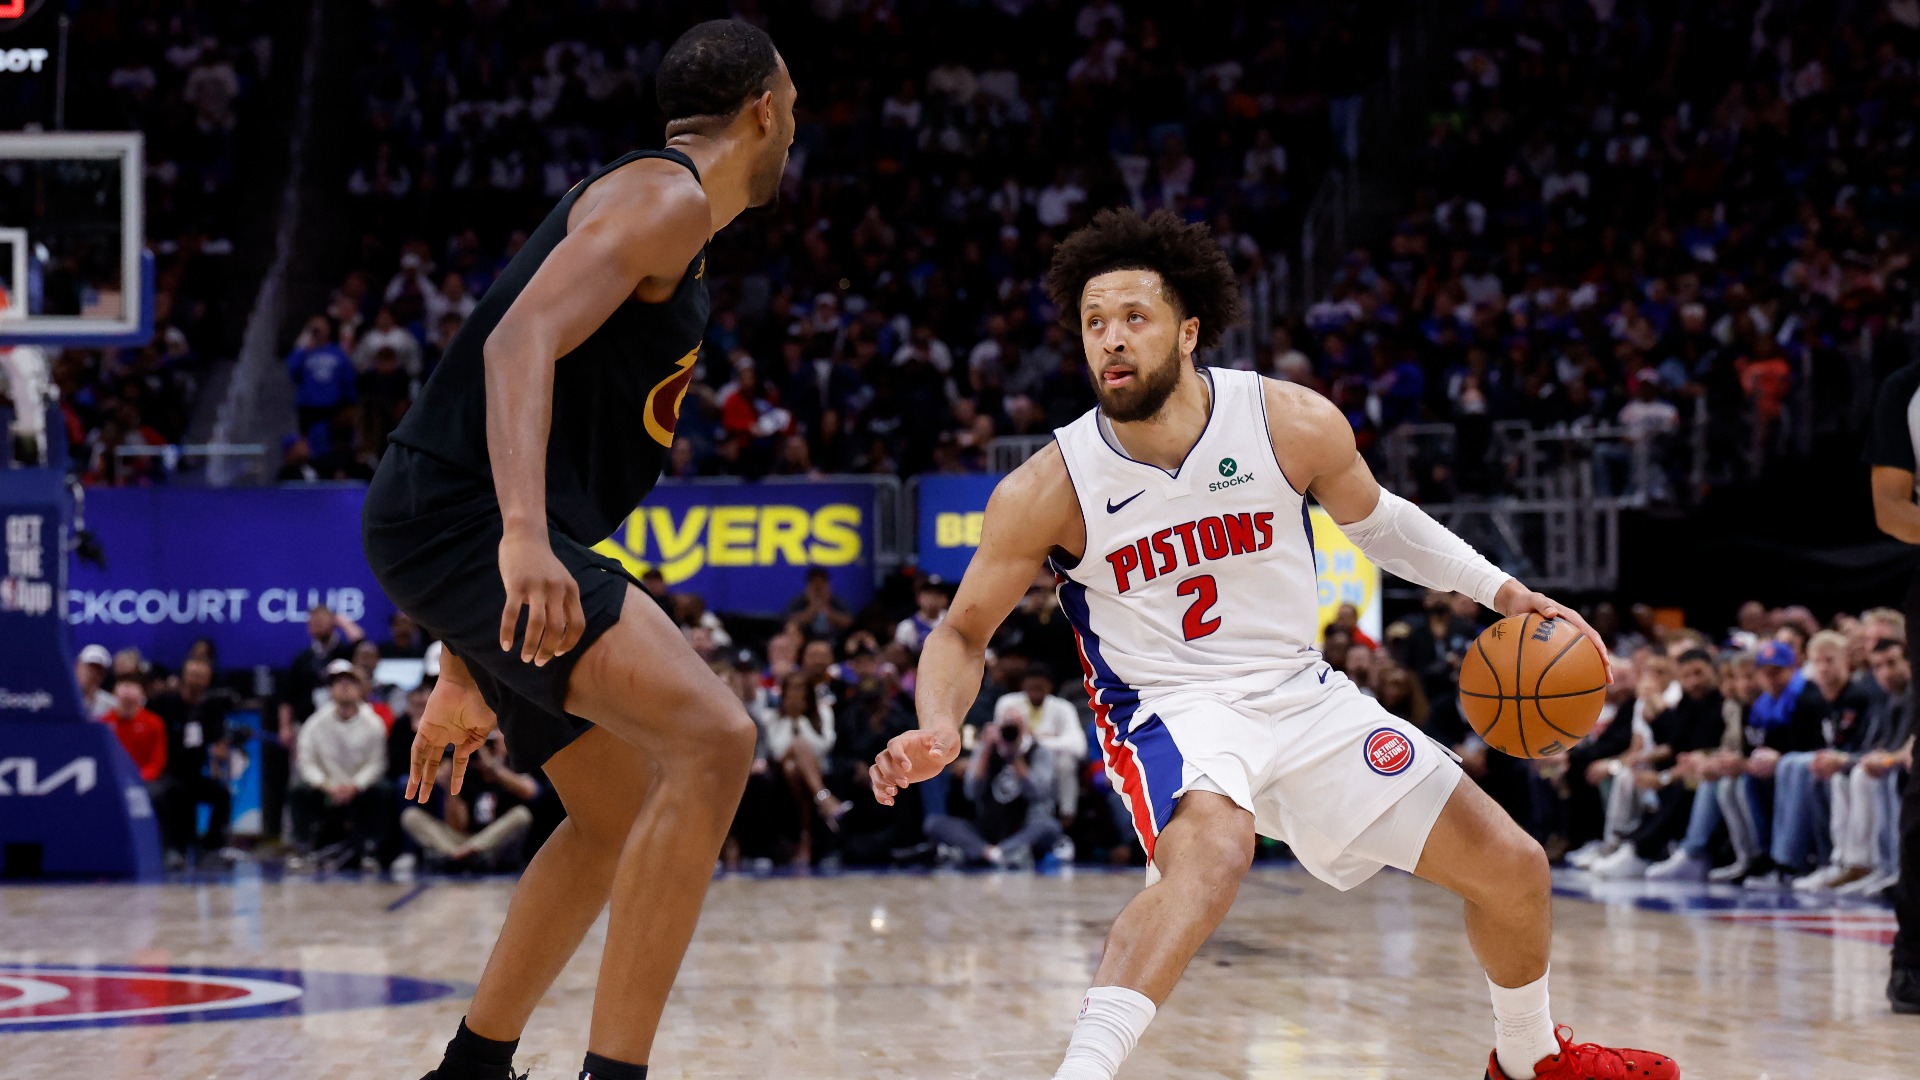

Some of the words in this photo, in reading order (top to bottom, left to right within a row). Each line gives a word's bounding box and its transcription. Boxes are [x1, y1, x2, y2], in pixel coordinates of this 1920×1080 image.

[1208, 472, 1255, 492] StockX
[1106, 512, 1274, 595] PISTONS
[66, 588, 249, 625] CKCOURT
[258, 587, 366, 624] CLUB
[1176, 574, 1222, 642] 2
[1372, 737, 1401, 760] DETROIT
[1377, 743, 1406, 766] PISTONS
